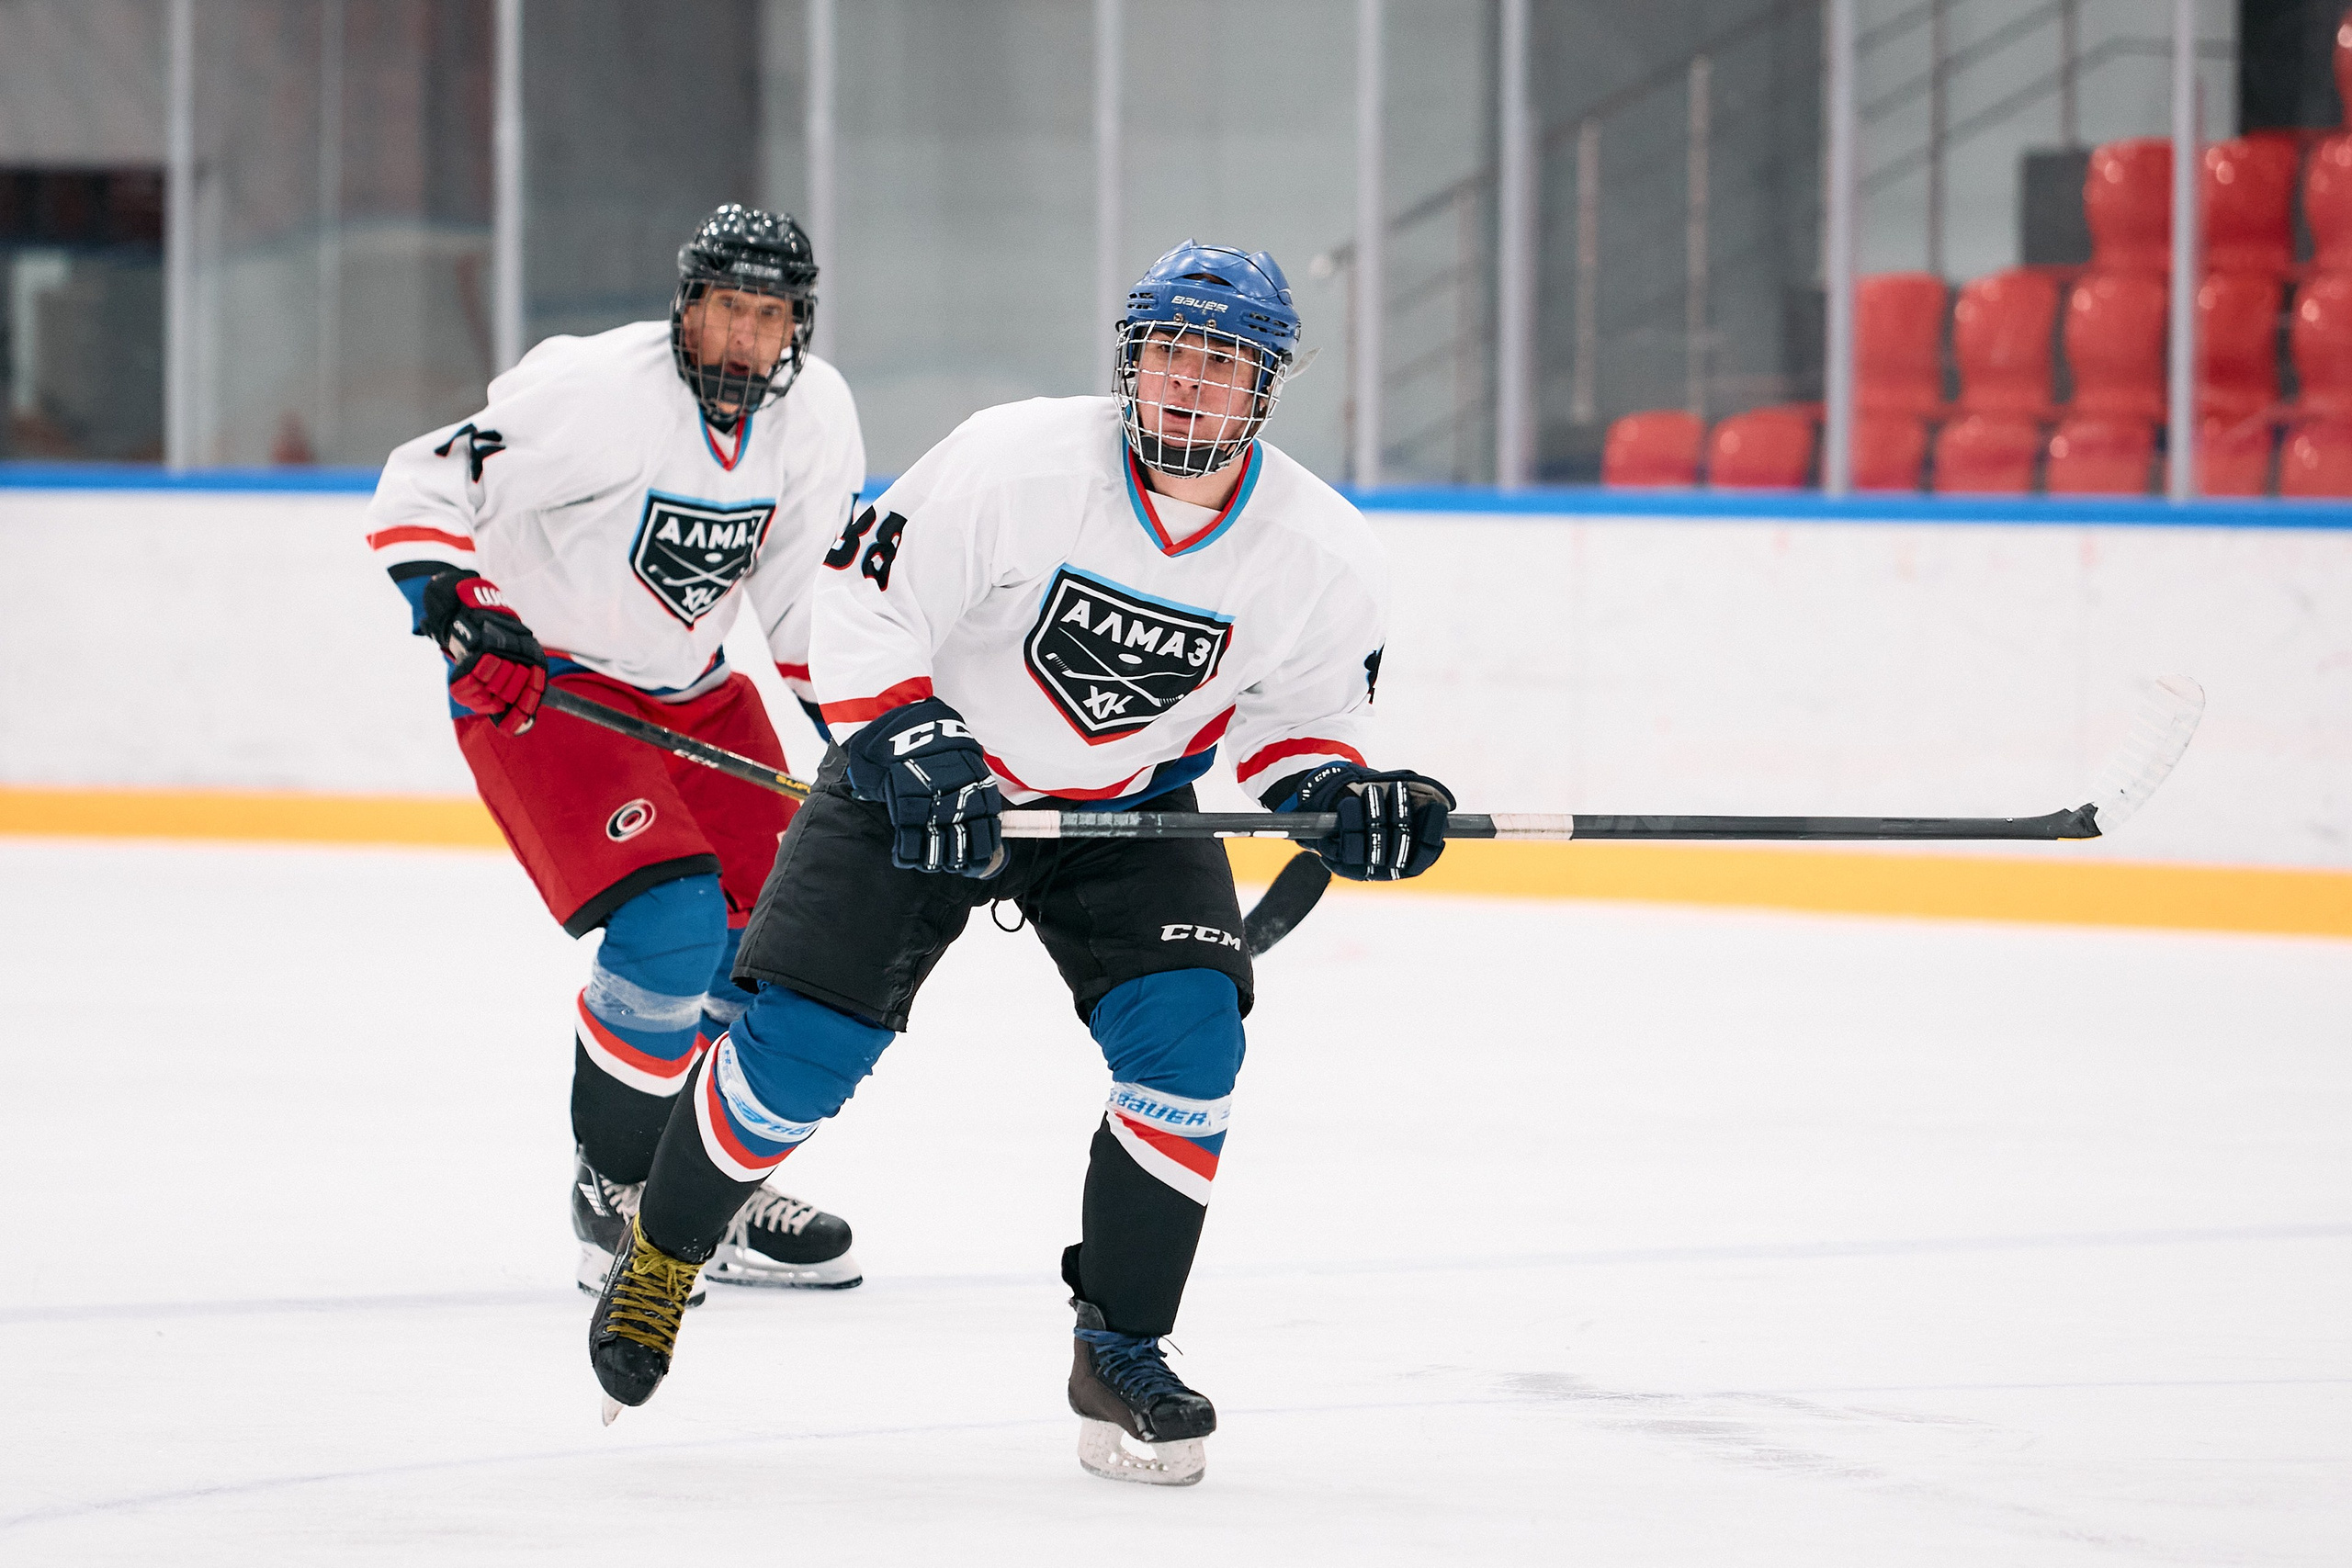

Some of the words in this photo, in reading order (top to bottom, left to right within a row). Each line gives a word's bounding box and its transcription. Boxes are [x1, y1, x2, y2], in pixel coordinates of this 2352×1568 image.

[1170, 294, 1229, 314] BAUER
[1059, 598, 1213, 668] АЛМАЗ
[1160, 924, 1241, 952] CCM
